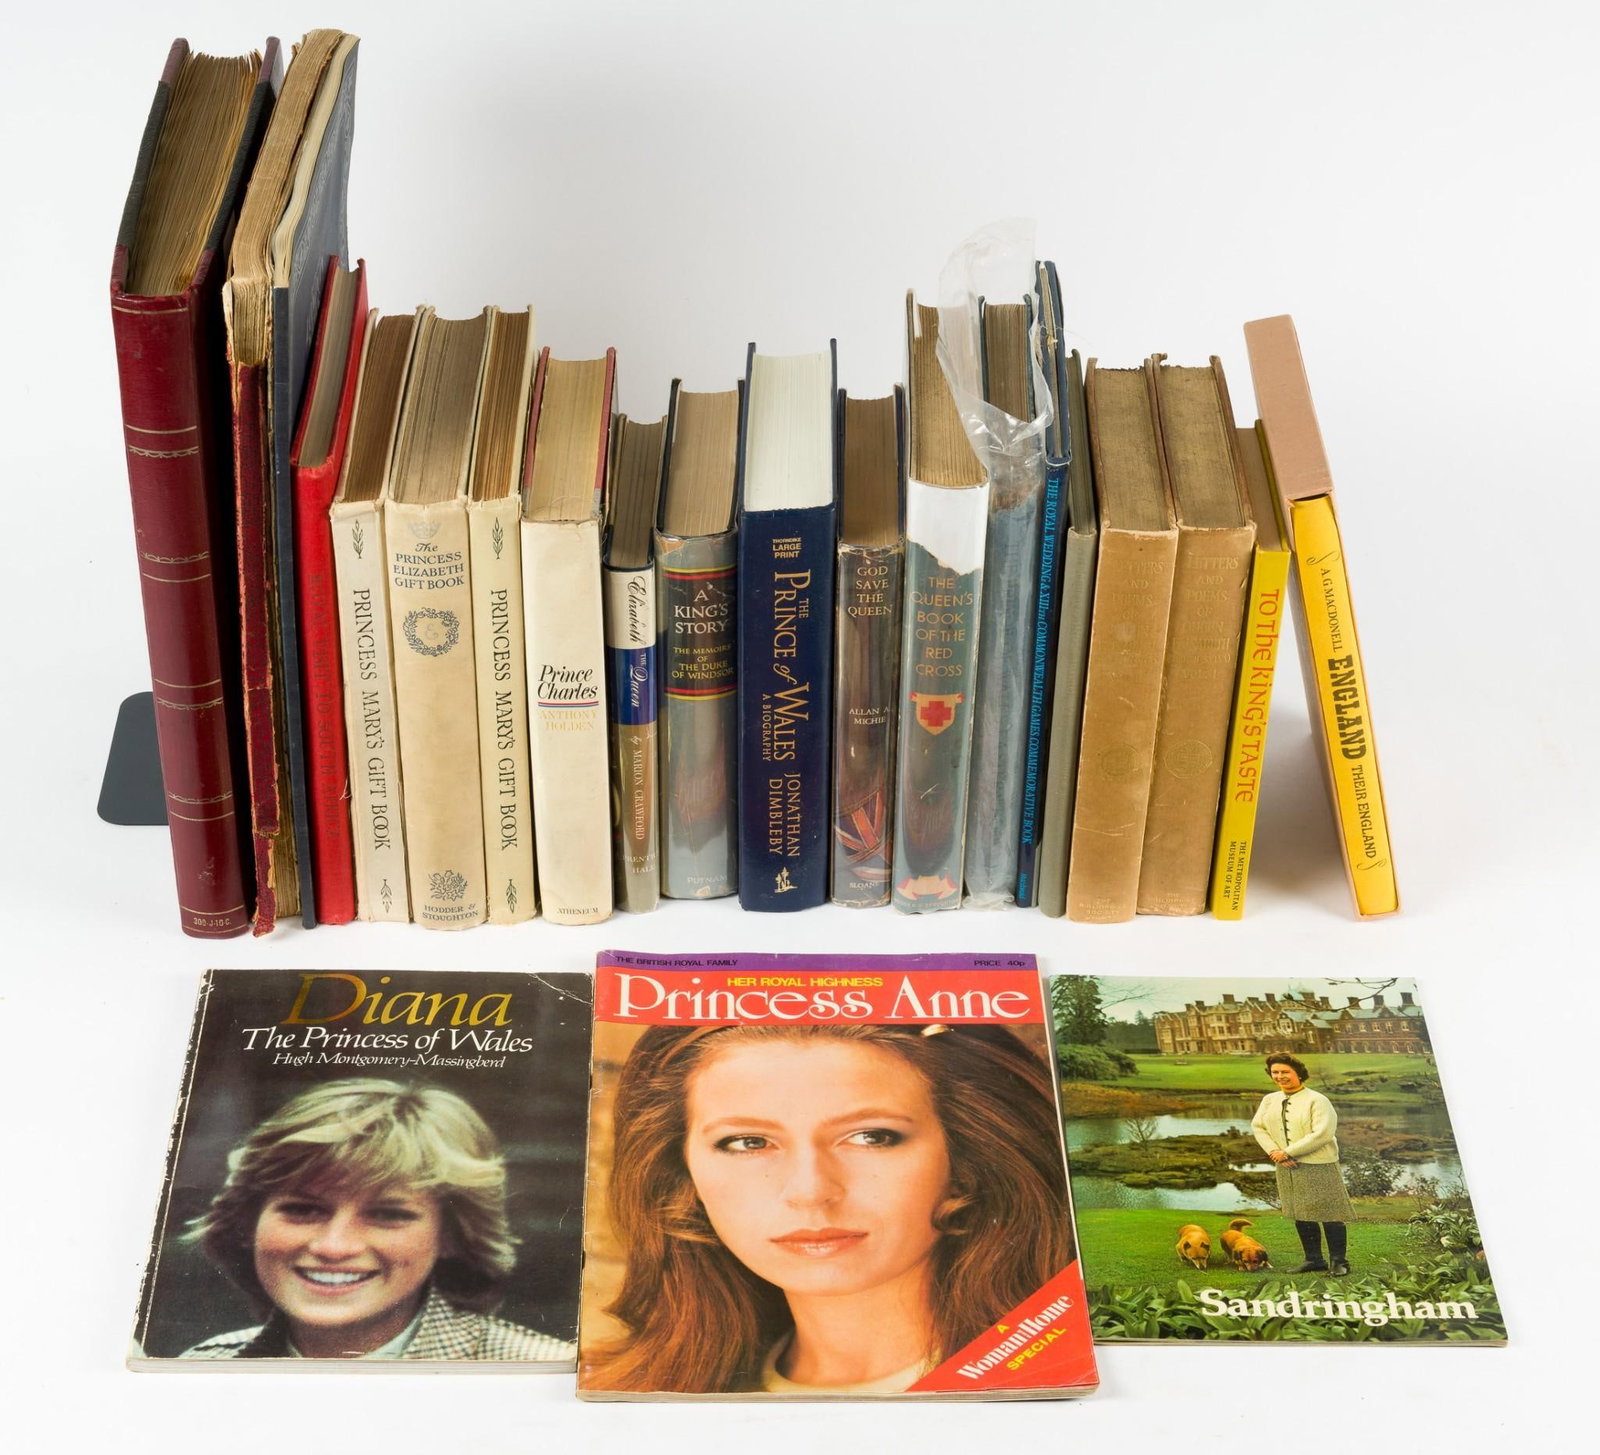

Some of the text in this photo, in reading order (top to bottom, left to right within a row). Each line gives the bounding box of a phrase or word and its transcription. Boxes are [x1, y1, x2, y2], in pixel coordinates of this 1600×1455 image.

[1046, 478, 1059, 502] THE
[1044, 502, 1058, 536] ROYAL
[415, 542, 438, 554] The
[772, 543, 801, 551] LARGE
[774, 550, 799, 558] PRINT
[395, 550, 463, 565] PRINCESS
[1041, 535, 1055, 583] WEDDING
[393, 563, 465, 578] ELIZABETH
[857, 565, 888, 577] GOD
[394, 574, 465, 590] GIFT BOOK
[855, 578, 889, 590] SAVE
[928, 577, 955, 590] THE
[1040, 584, 1049, 592] &
[694, 589, 709, 602] A
[856, 592, 883, 603] THE
[910, 590, 973, 607] QUEEN'S
[1259, 589, 1280, 617] TO
[627, 576, 649, 646] Elizabeth
[674, 603, 729, 618] KING'S
[799, 597, 810, 618] THE
[847, 603, 893, 618] QUEEN
[917, 611, 964, 625] BOOK
[675, 620, 729, 635] STORY
[915, 627, 965, 642] OF THE
[673, 644, 732, 655] THE MEMOIRS
[925, 647, 952, 660] RED
[679, 661, 728, 672] THE DUKE
[773, 569, 811, 761] PRINCE of WALES
[1032, 621, 1048, 704] COMMONWEALTH
[538, 663, 593, 685] Prince
[672, 669, 734, 680] OF WINDSOR
[915, 664, 963, 678] CROSS
[629, 652, 649, 709] THE Queen
[536, 682, 600, 702] Charles
[315, 690, 332, 715] TO
[353, 588, 391, 851] PRINCESS MARY'S GIFT BOOK
[490, 588, 518, 851] PRINCESS MARY'S GIFT BOOK
[538, 710, 599, 721] ANTHONY
[849, 707, 880, 716] ALLAN
[1320, 567, 1377, 859] A G MACDONELL ENGLAND THEIR ENGLAND
[545, 720, 595, 732] HOLDEN
[761, 693, 771, 762] A BIOGRAPHY
[854, 715, 886, 725] MICHIE
[1030, 705, 1043, 737] GAMES
[316, 719, 337, 776] SOUTH
[632, 749, 644, 785] MARION
[1235, 739, 1261, 803] TASTE
[1023, 737, 1040, 818] COMMEMORATIVE
[634, 788, 644, 841] CRAWFORD
[768, 779, 783, 855] DIMBLEBY
[785, 773, 802, 857] JONATHAN
[1022, 819, 1034, 845] BOOK
[1223, 840, 1237, 900] MUSEUM OF ART
[1231, 840, 1247, 912] THE METROPOLITAN
[687, 875, 727, 885] PUTNAM
[422, 909, 479, 922] STOUGHTON
[424, 903, 464, 914] HODDER
[557, 905, 600, 915] ATHENEUM
[614, 956, 738, 967] THE BRITISH ROYAL FAMILY
[1007, 960, 1026, 968] 40p
[727, 976, 884, 988] HER ROYAL HIGHNESS
[281, 973, 513, 1028] Diana
[613, 973, 1031, 1021] Princess Anne
[242, 1026, 534, 1053] The Princess of Wales
[272, 1051, 507, 1070] Hugh Montgomery-Massingberd
[1199, 1288, 1479, 1327] Sandringham
[996, 1324, 1011, 1334] A
[1006, 1327, 1067, 1371] SPECIAL
